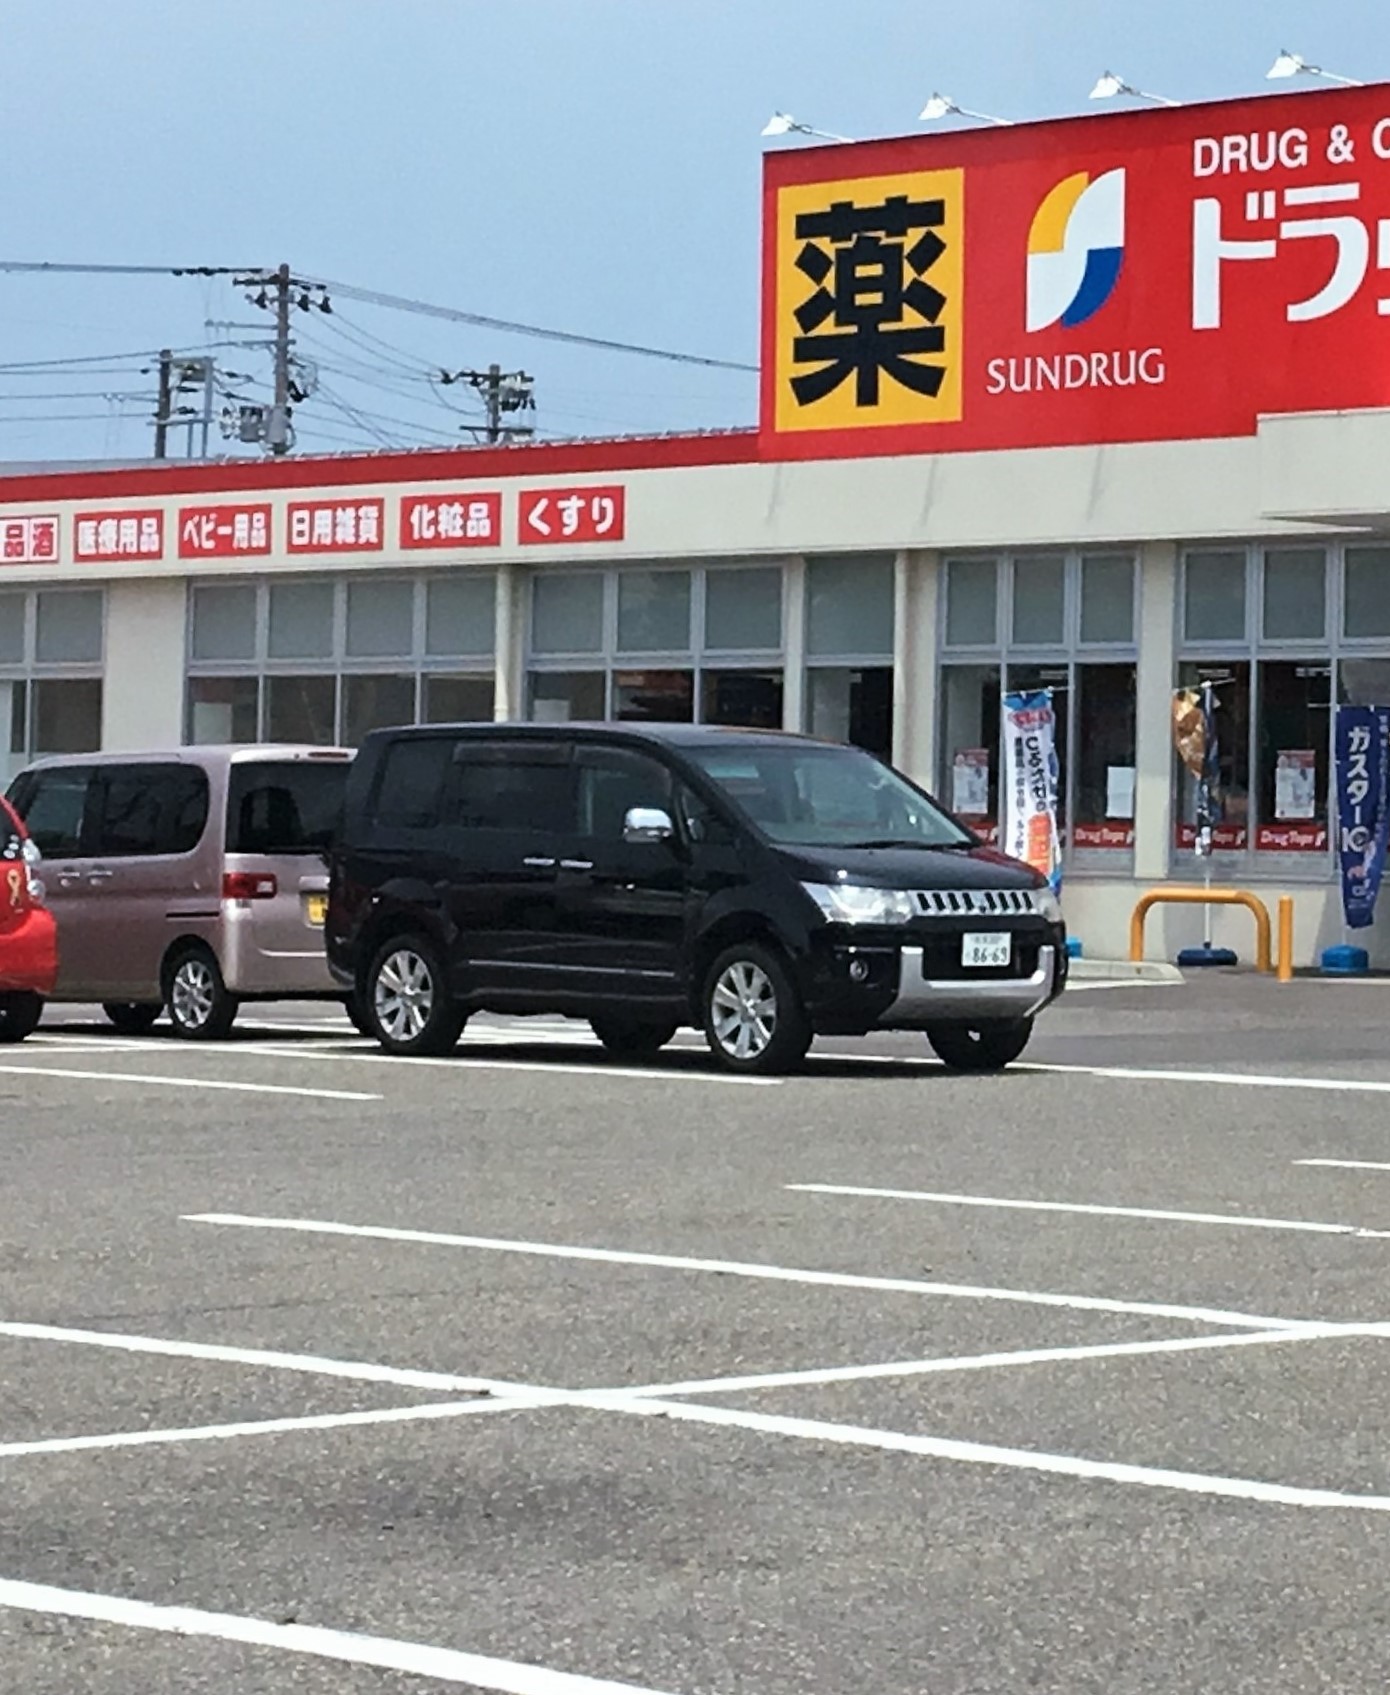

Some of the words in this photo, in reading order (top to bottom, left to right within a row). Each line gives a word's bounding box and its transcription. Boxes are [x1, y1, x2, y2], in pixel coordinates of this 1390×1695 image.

[1193, 128, 1308, 177] DRUG
[1326, 124, 1355, 164] &
[789, 195, 947, 407] 薬
[986, 348, 1165, 394] SUNDRUG
[291, 505, 380, 546] 日用雑貨
[409, 501, 492, 540] 化粧品
[528, 494, 614, 536] くすり
[77, 517, 160, 556] 医療用品
